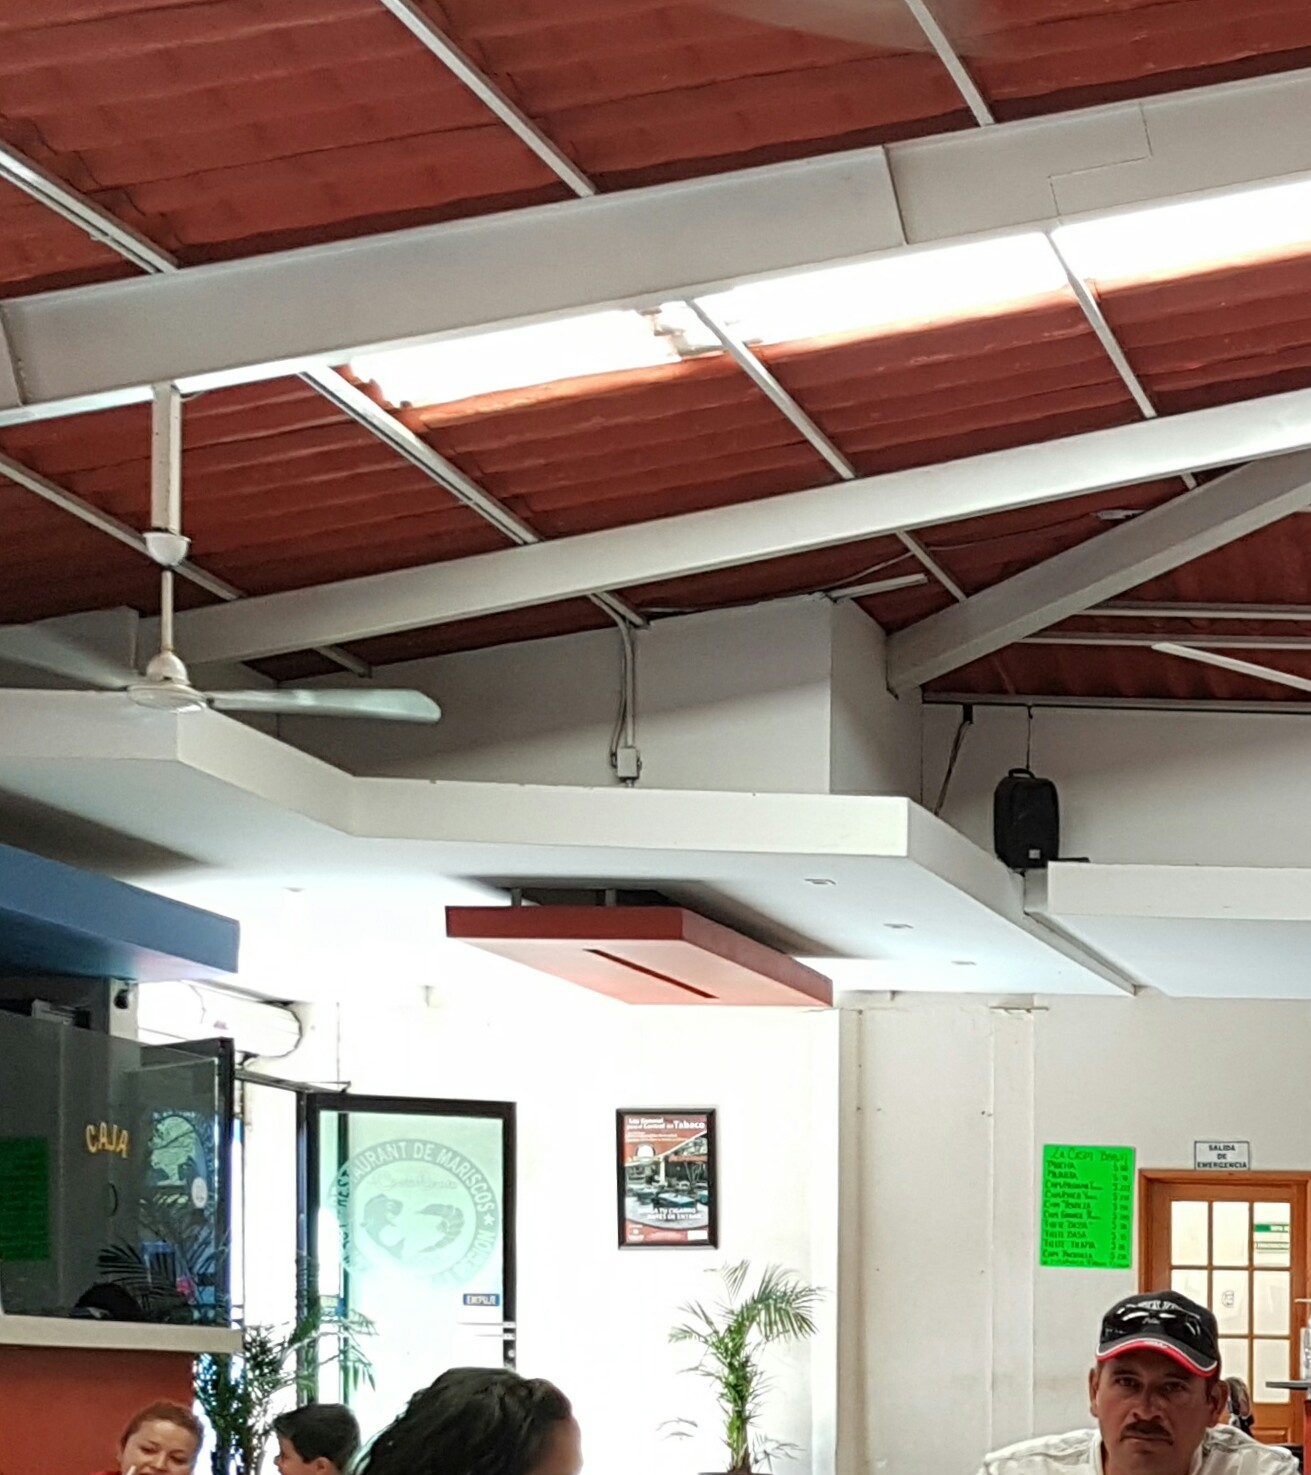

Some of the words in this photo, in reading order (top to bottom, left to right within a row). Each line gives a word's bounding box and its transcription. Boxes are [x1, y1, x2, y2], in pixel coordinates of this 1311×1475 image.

[86, 1121, 129, 1158] CAJA
[674, 1120, 705, 1129] Tabaco
[413, 1142, 435, 1161] DE
[436, 1148, 495, 1211] MARISCOS
